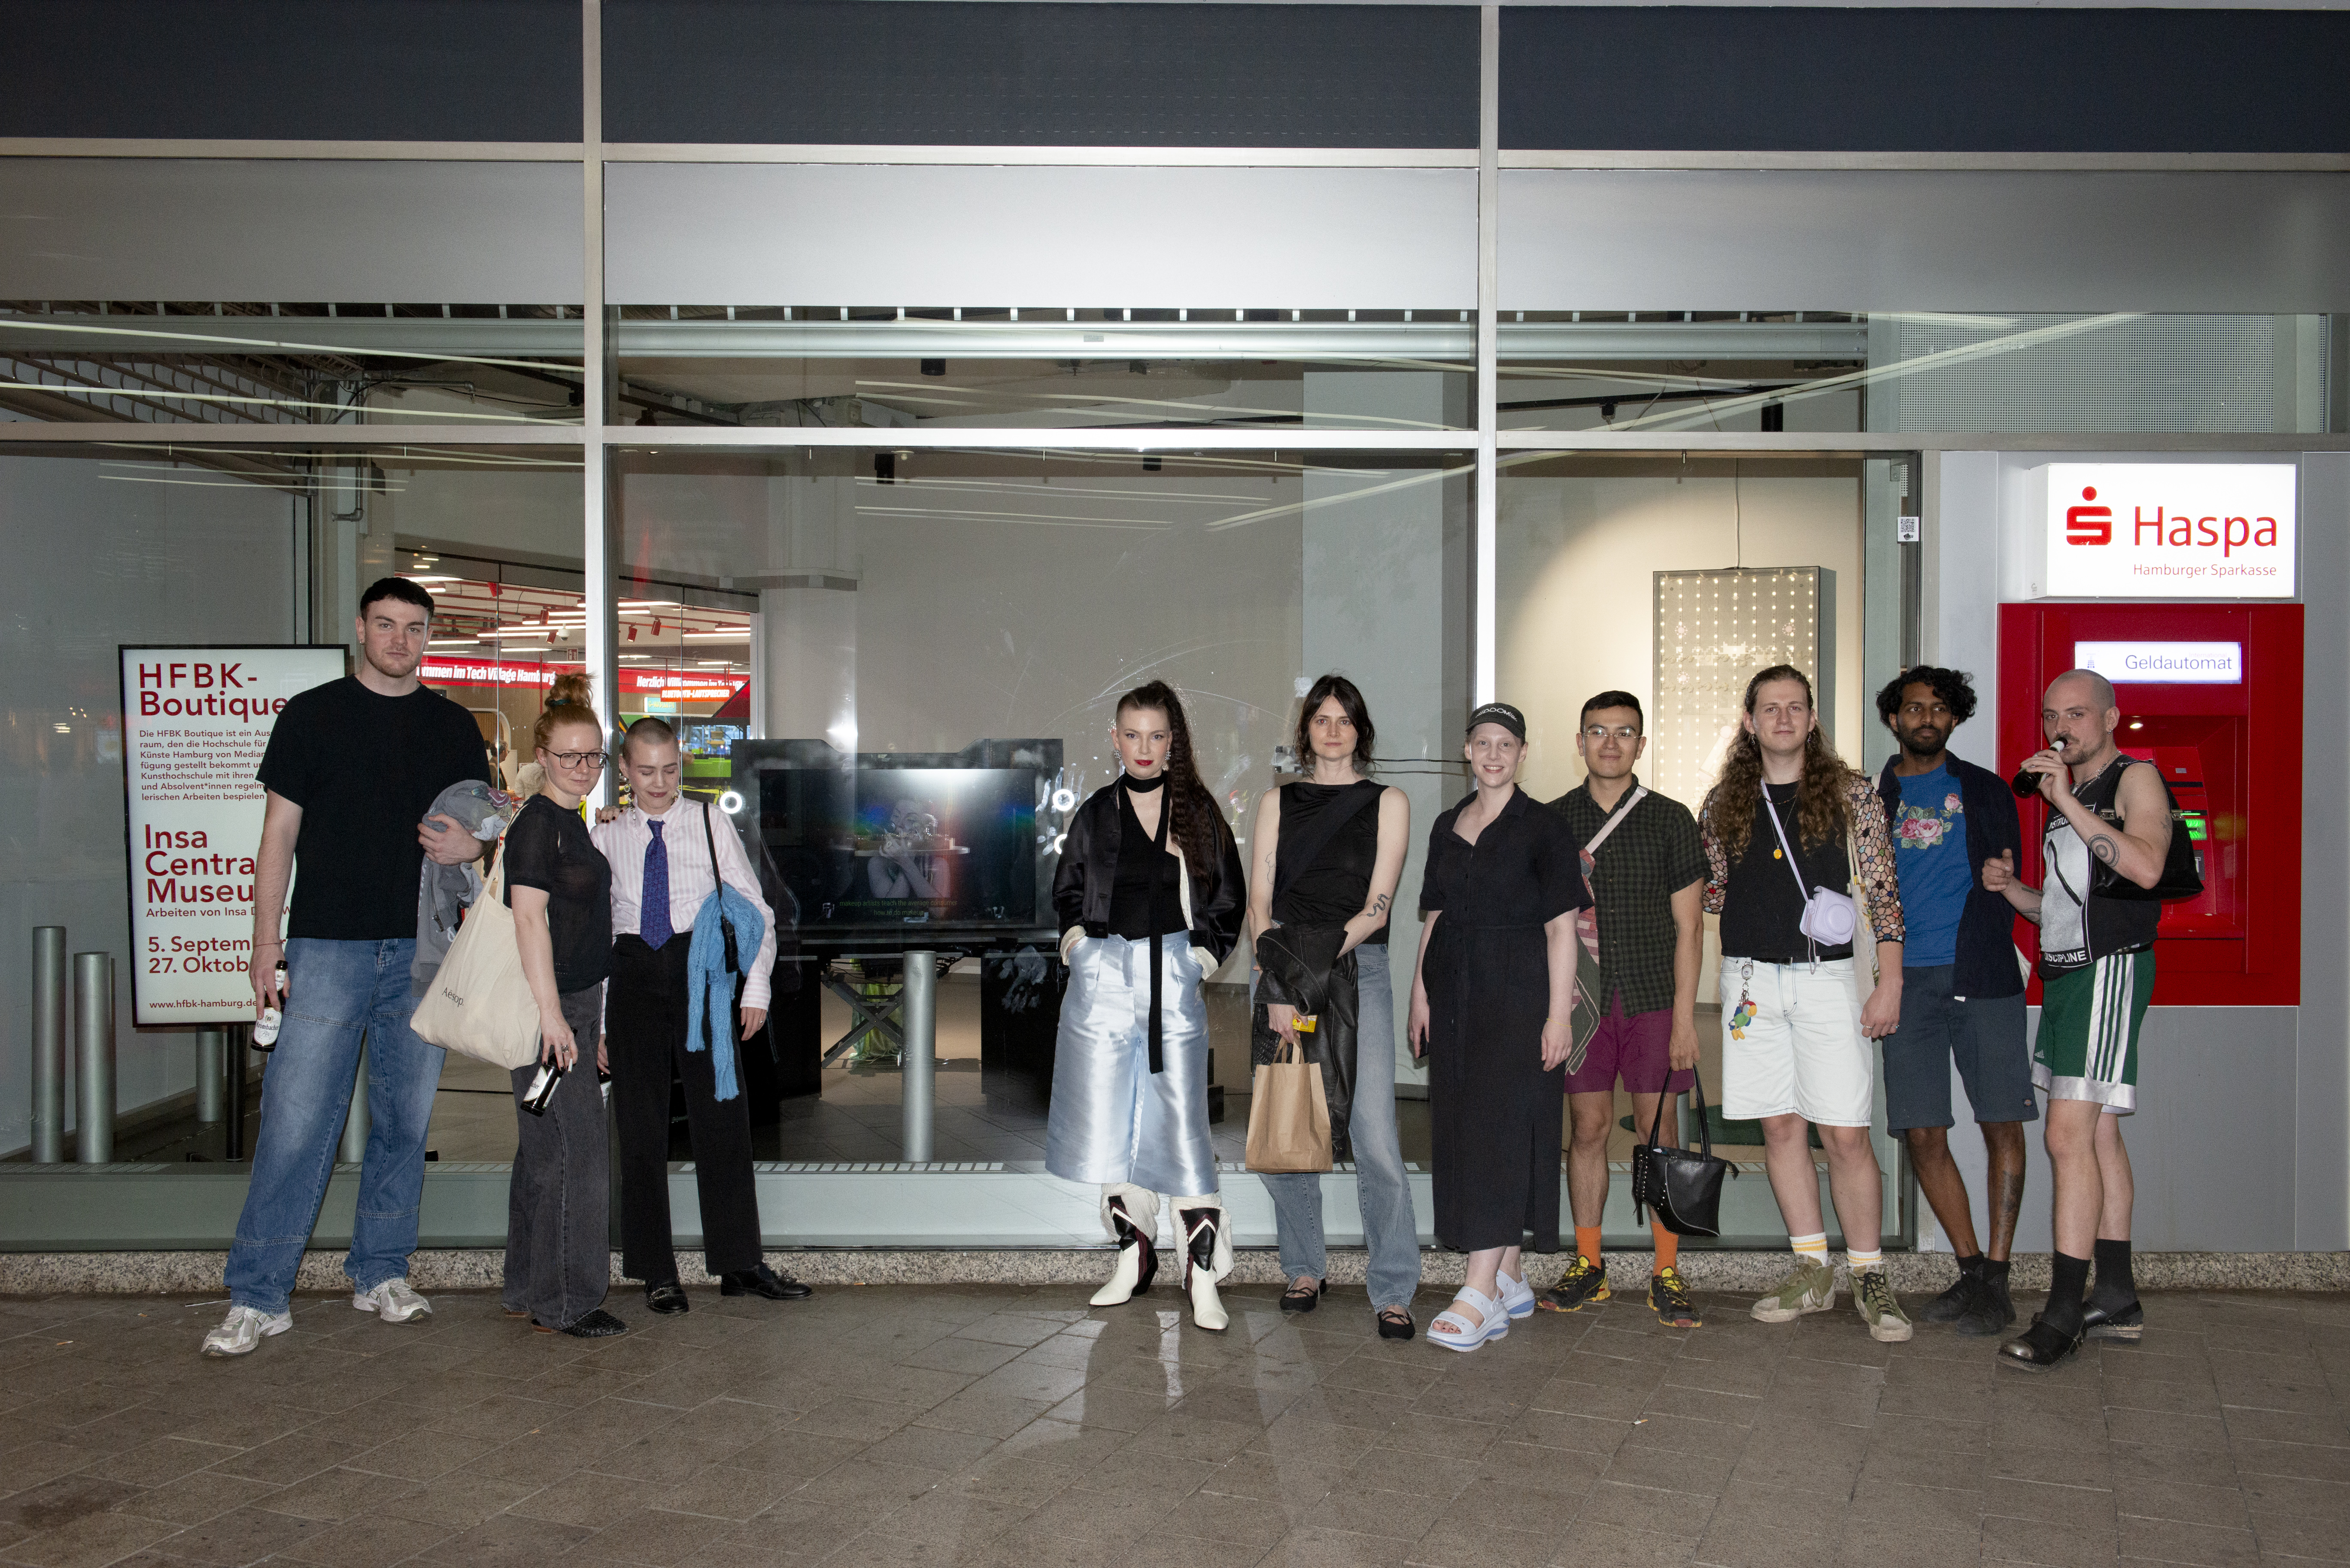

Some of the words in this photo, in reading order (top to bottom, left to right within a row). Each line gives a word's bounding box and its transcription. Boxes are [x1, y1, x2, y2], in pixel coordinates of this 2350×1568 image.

[2135, 506, 2276, 557] Haspa
[2134, 564, 2207, 578] Hamburger
[2211, 564, 2276, 578] Sparkasse
[2125, 655, 2232, 670] Geldautomat
[140, 664, 257, 688] HFBK-
[453, 665, 466, 679] im
[467, 666, 486, 680] Tech
[517, 669, 556, 685] Hamburg
[637, 676, 665, 688] Herzlich
[141, 691, 288, 723] Boutique
[185, 730, 223, 738] Boutique
[173, 751, 213, 760] Hamburg
[140, 761, 171, 770] fügung
[174, 761, 206, 770] gestellt
[224, 792, 264, 801] bespielen
[146, 824, 207, 849] Insa
[146, 851, 254, 876] Centra
[148, 878, 254, 903] Museu
[146, 908, 196, 917] Arbeiten
[225, 907, 246, 916] Insa
[149, 937, 165, 952] 5.
[149, 958, 177, 973] 27.
[183, 954, 248, 973] Oktob
[2044, 950, 2087, 963] DISCIPLINE
[149, 999, 257, 1008] www.hfbk-hamburg.de
[256, 1021, 279, 1031] Krombacher
